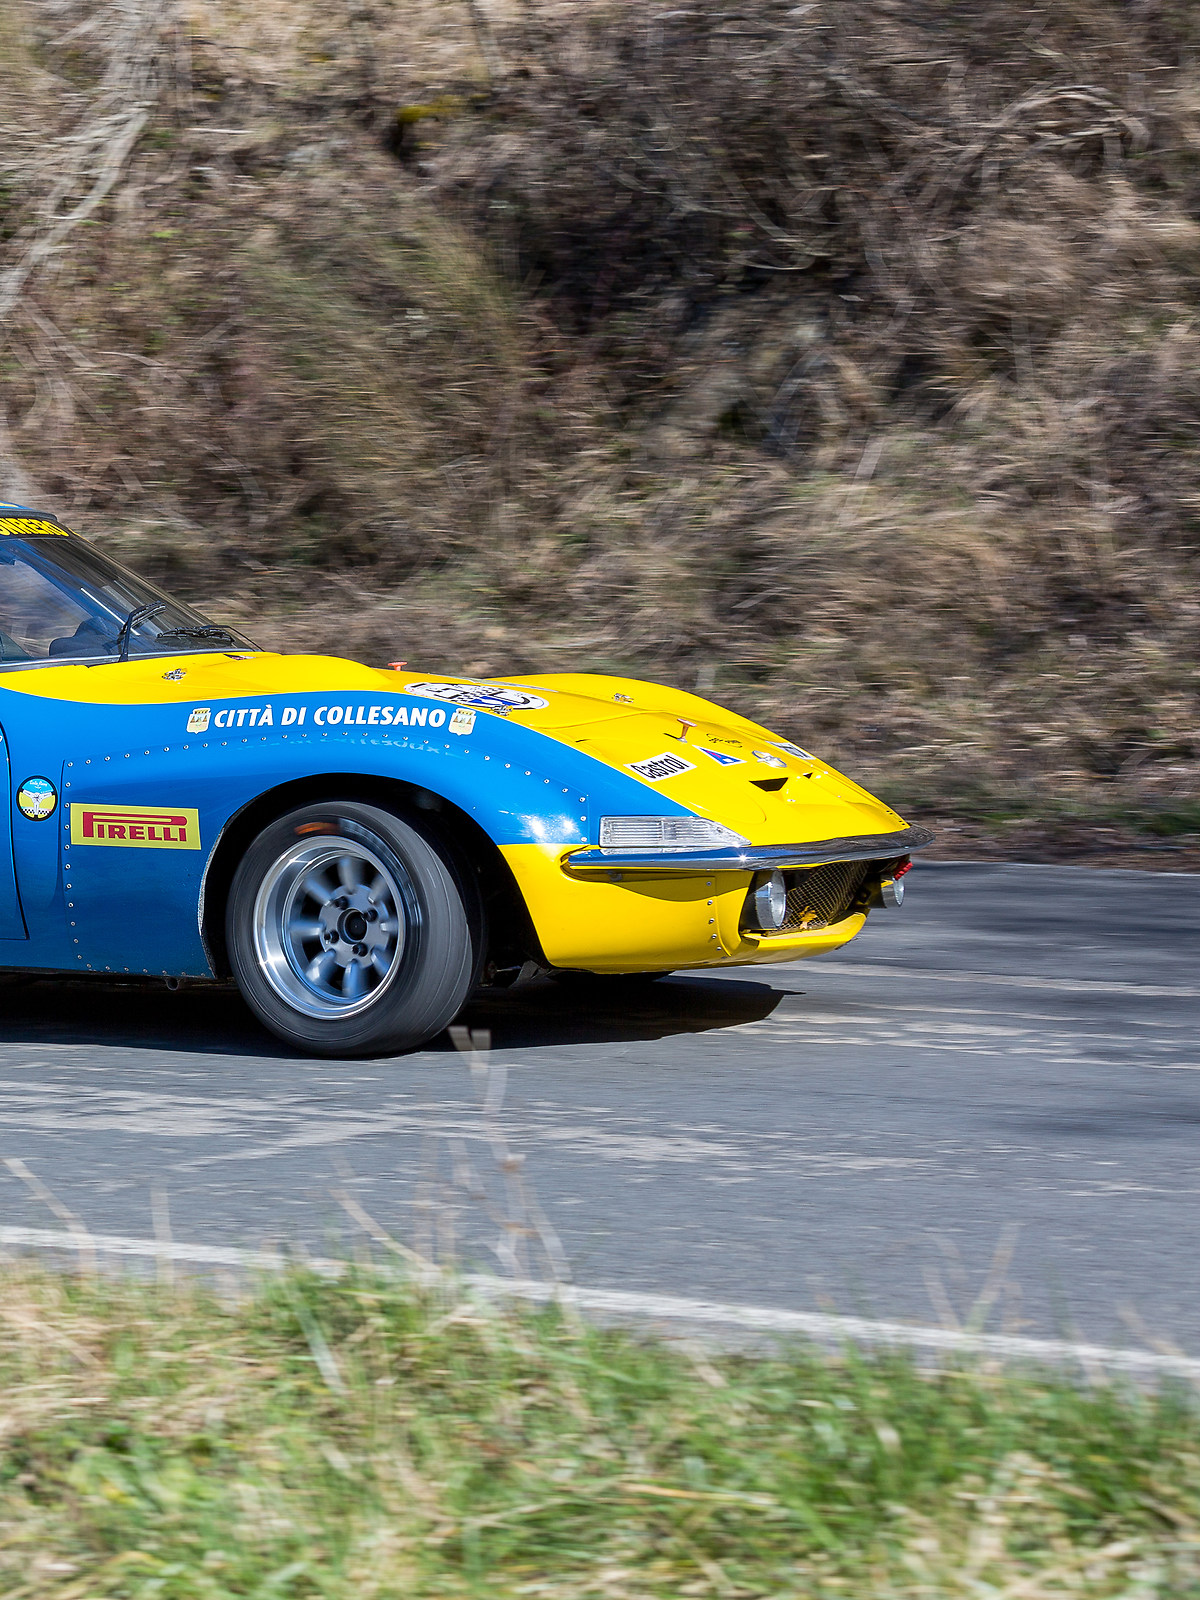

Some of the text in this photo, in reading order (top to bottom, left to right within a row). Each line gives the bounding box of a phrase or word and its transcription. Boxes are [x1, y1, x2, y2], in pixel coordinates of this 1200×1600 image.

[214, 704, 447, 728] CITTÀ DI COLLESANO
[630, 754, 690, 779] Castrol
[82, 811, 188, 842] PIRELLI
